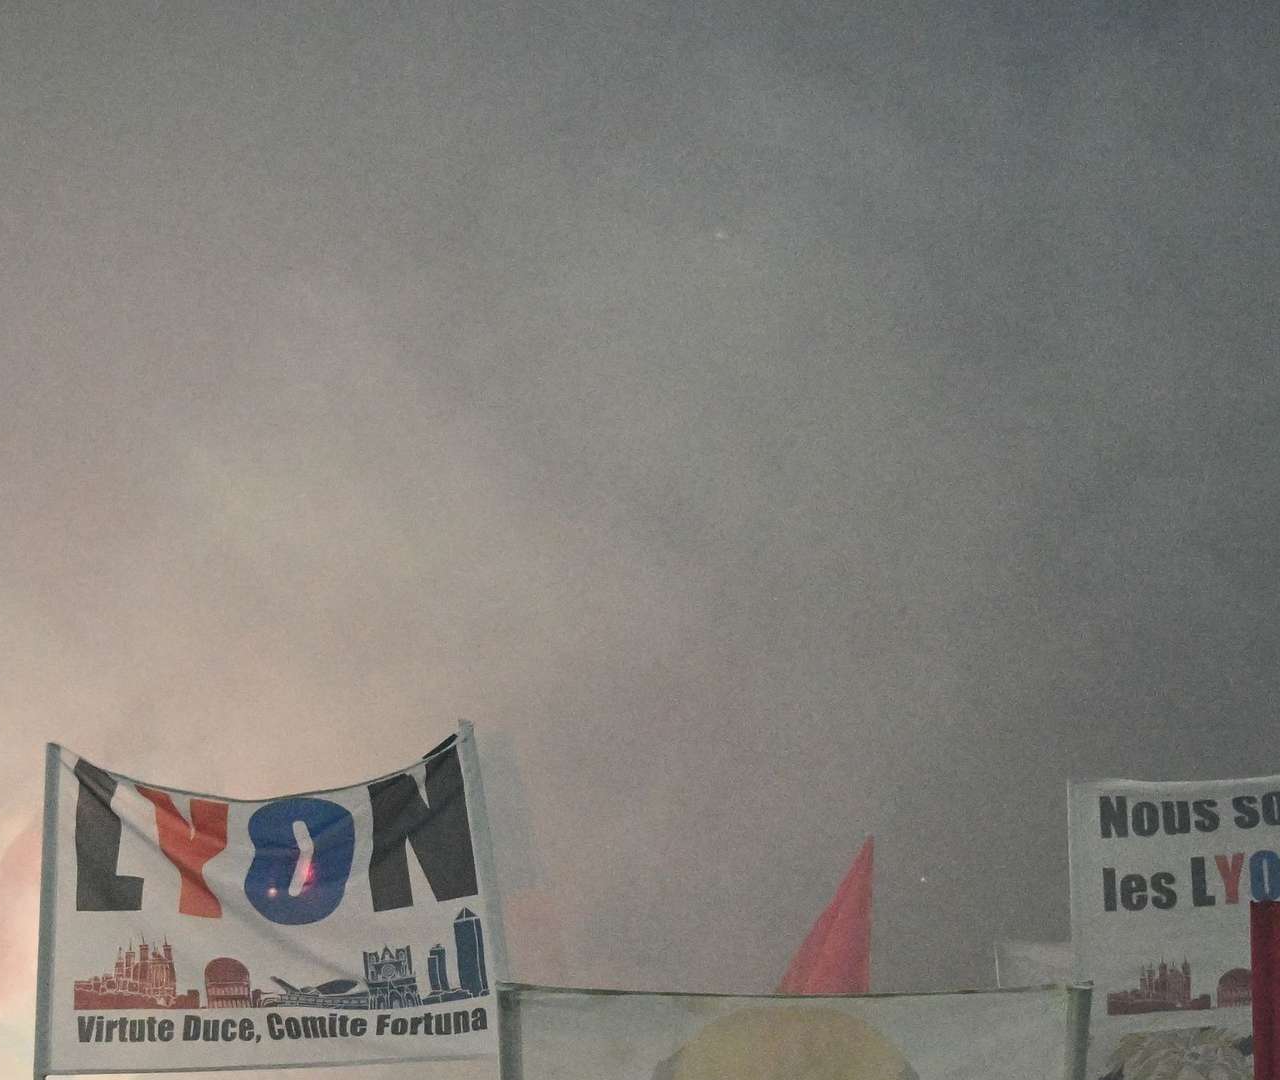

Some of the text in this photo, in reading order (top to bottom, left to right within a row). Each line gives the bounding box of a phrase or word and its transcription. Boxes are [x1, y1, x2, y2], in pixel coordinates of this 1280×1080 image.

[74, 734, 478, 925] LYON
[1100, 795, 1220, 839] Nous
[1102, 867, 1177, 912] les
[76, 1006, 489, 1044] Virtute Duce, Comite Fortuna
